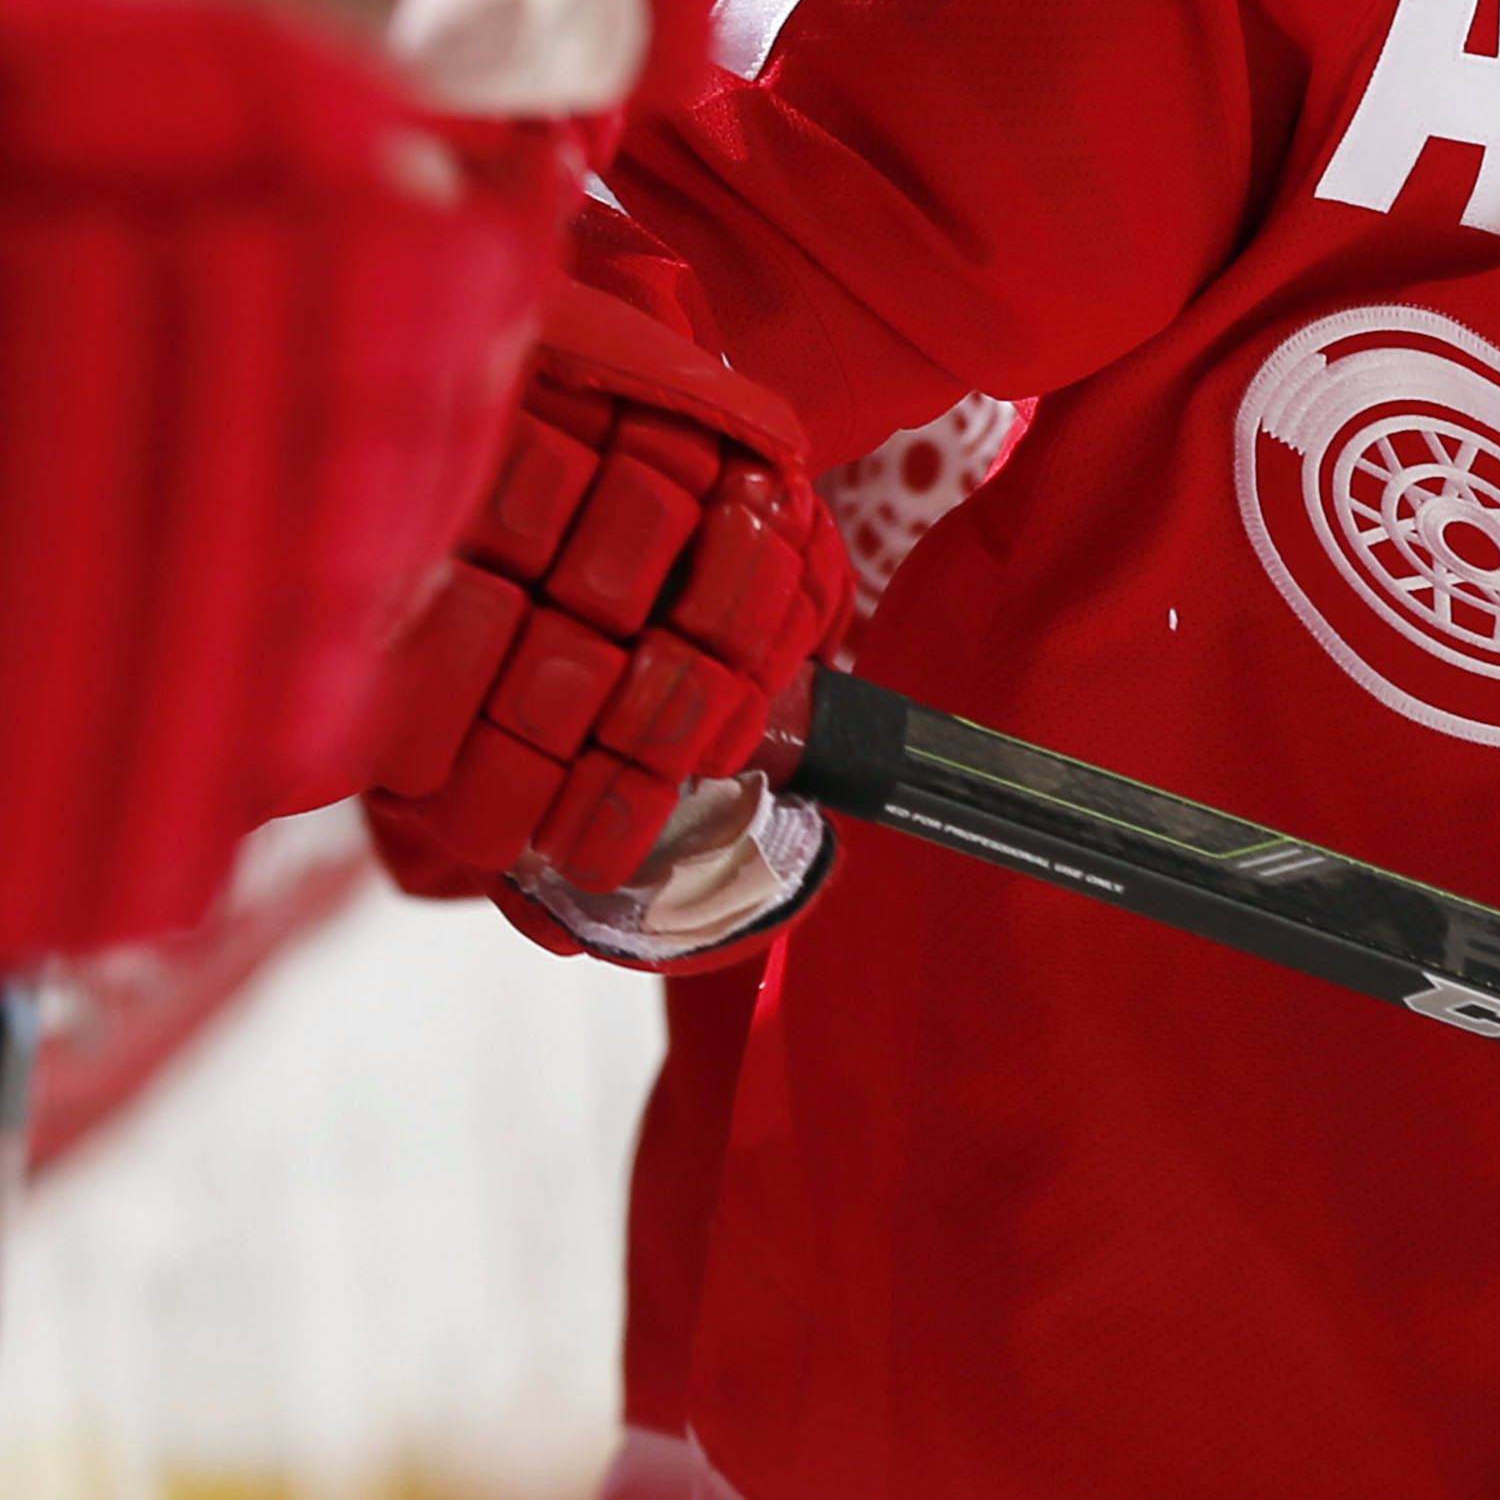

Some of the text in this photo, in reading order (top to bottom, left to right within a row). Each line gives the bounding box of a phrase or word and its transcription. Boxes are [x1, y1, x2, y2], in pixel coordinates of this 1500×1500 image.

[912, 812, 942, 830] FOR
[943, 824, 1050, 869] PROFESSIONAL
[1085, 874, 1125, 894] ONLY
